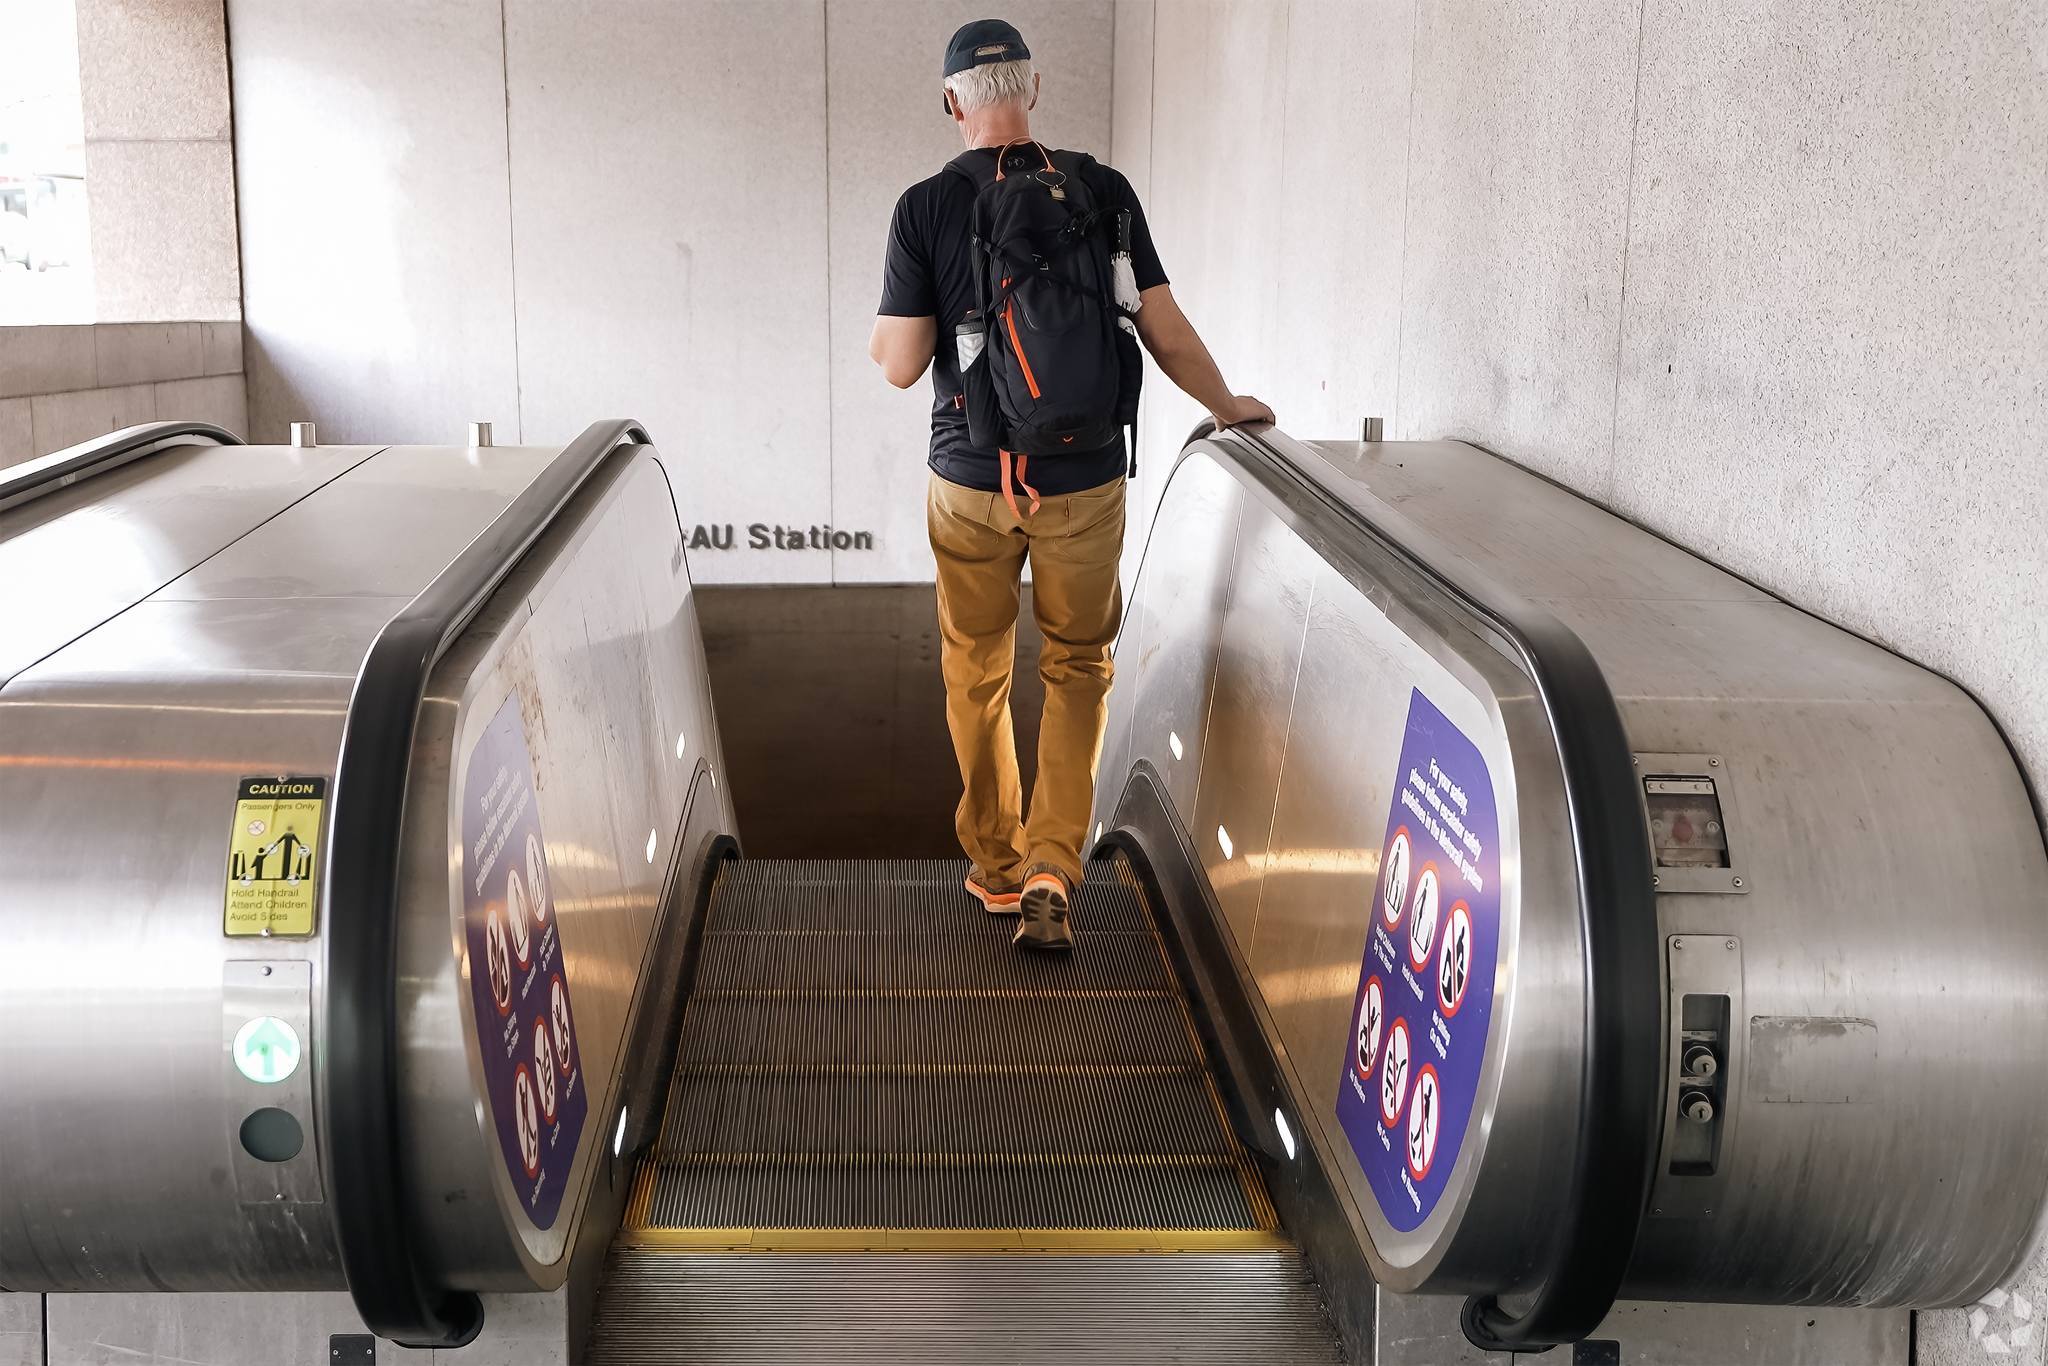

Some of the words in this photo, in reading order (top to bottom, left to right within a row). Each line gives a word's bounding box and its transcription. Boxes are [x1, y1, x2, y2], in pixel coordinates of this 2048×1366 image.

[748, 523, 872, 550] Station
[1428, 757, 1440, 781] For
[1437, 771, 1452, 793] your
[249, 784, 314, 795] CAUTION
[241, 802, 293, 812] Passengers
[295, 803, 316, 811] Only
[1408, 767, 1426, 795] please
[1424, 782, 1441, 812] follow
[1440, 803, 1465, 839] escalator
[1463, 830, 1482, 862] safety
[1401, 787, 1426, 824] guidelines
[1424, 811, 1432, 831] in
[1430, 818, 1440, 841] the
[1461, 859, 1483, 893] system
[231, 888, 254, 898] Hold
[257, 888, 299, 898] Handrail
[230, 900, 263, 909] Attend
[265, 900, 307, 909] Children
[229, 912, 257, 921] Avoid
[260, 912, 288, 921] Sdes
